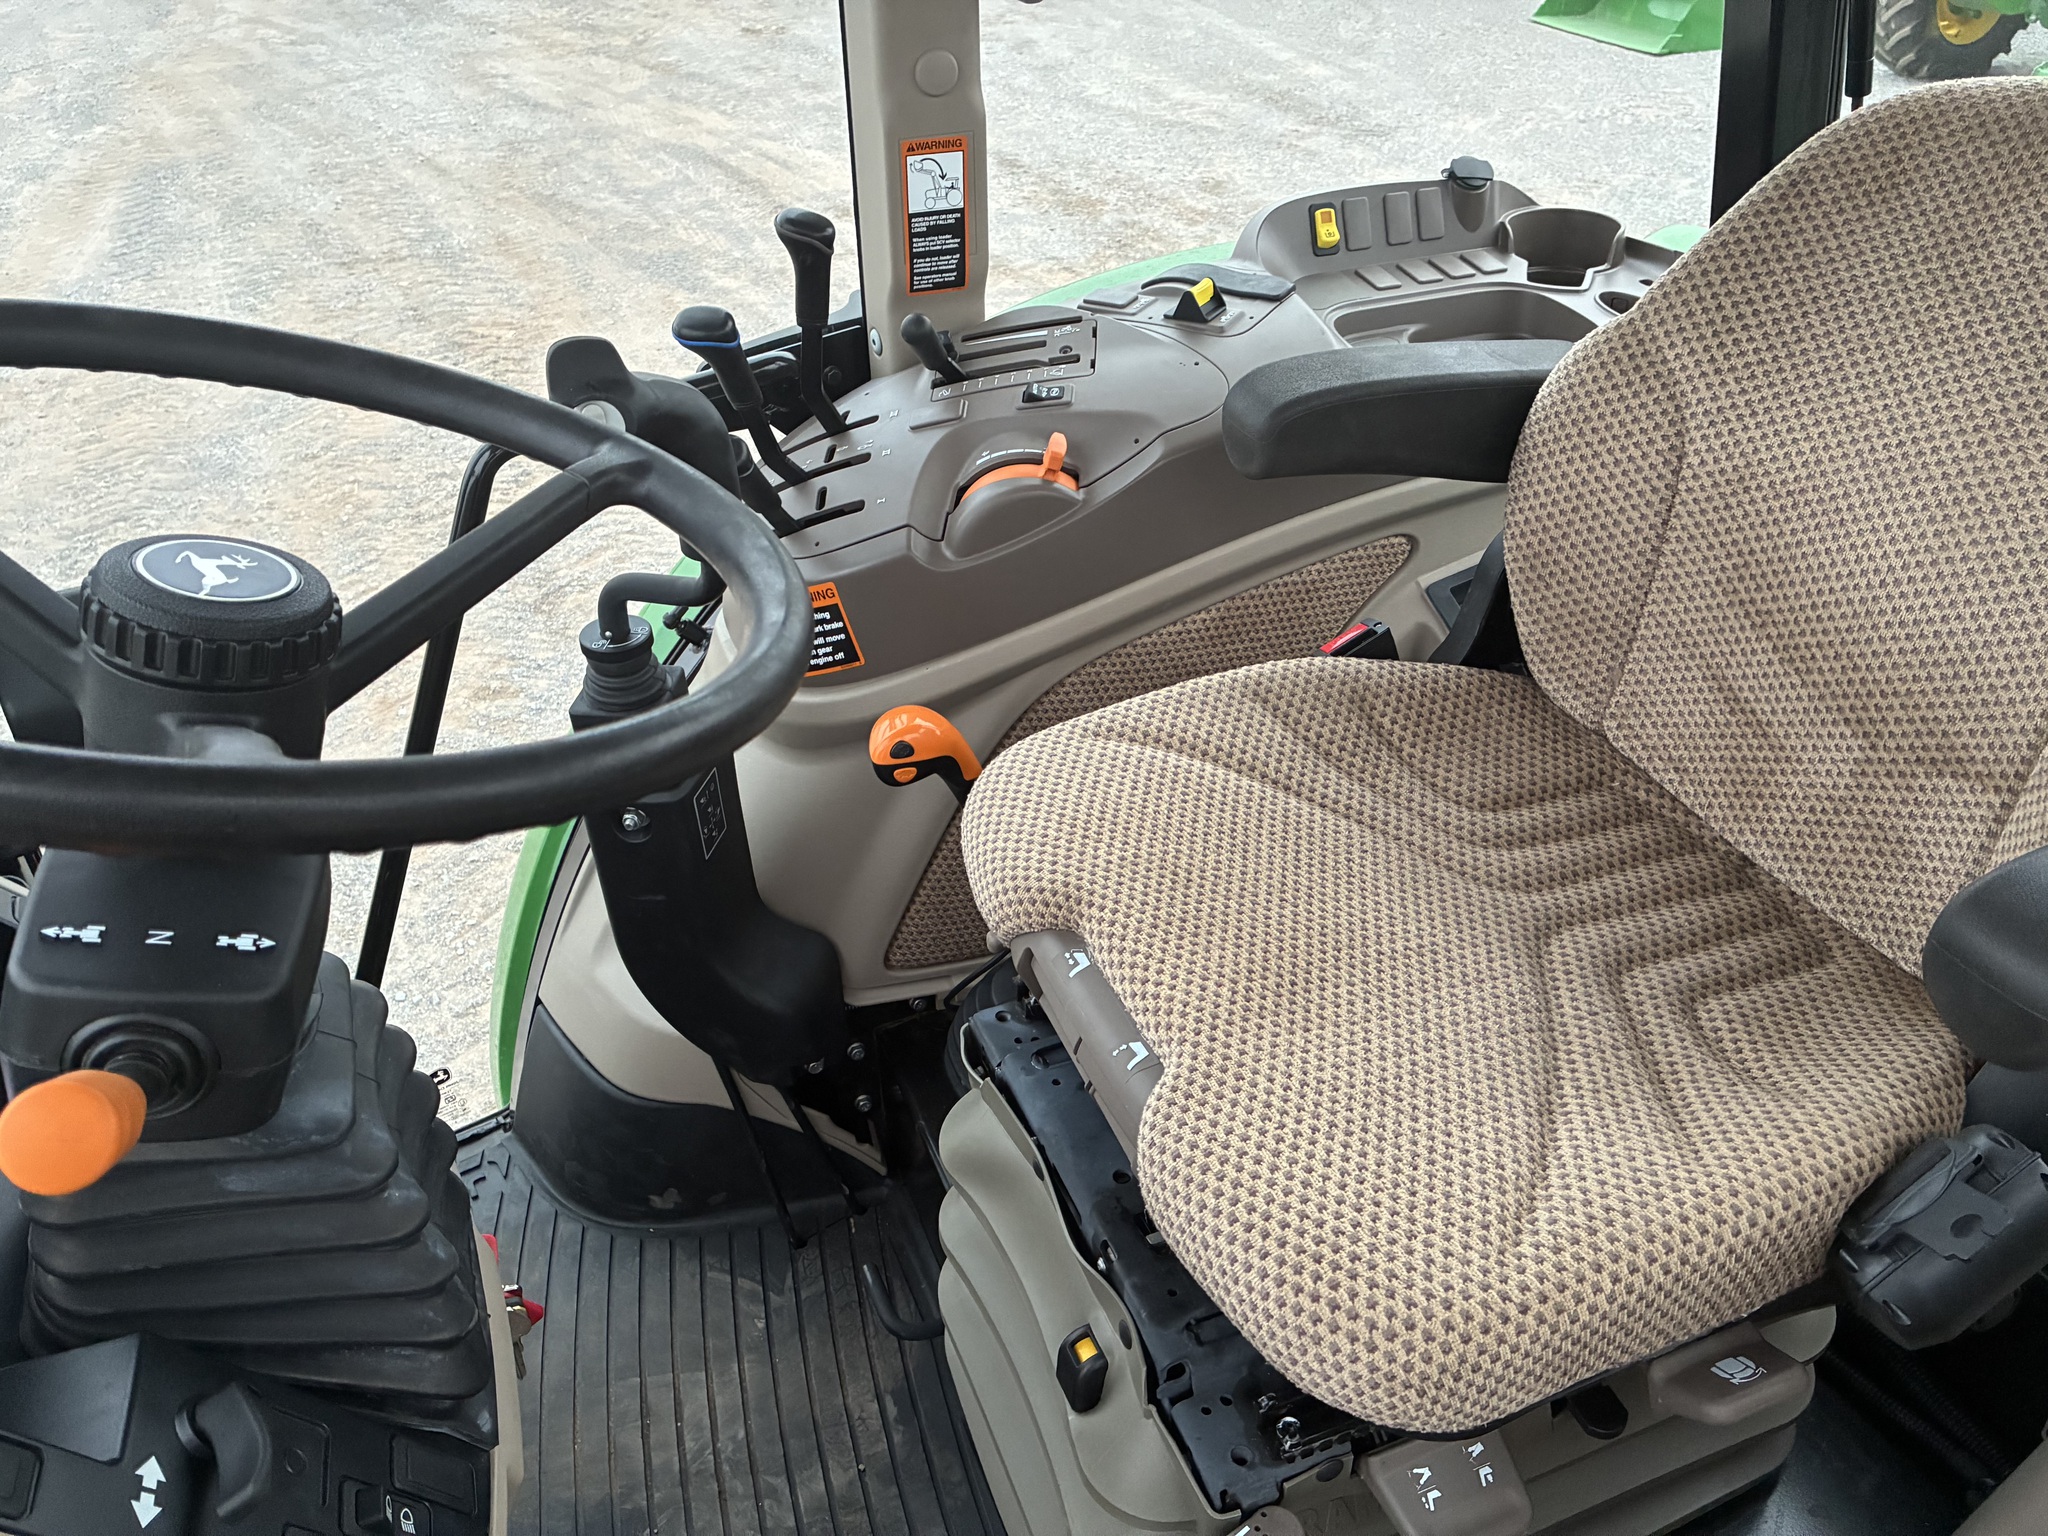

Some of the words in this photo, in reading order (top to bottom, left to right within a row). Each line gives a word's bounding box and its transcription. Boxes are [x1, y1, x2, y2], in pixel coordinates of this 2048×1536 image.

[915, 138, 962, 152] WARNING
[813, 612, 830, 620] hing
[814, 625, 824, 633] ark
[823, 621, 844, 631] brake
[826, 633, 846, 643] move
[817, 646, 833, 655] gear
[810, 656, 833, 665] engine
[834, 652, 845, 660] off
